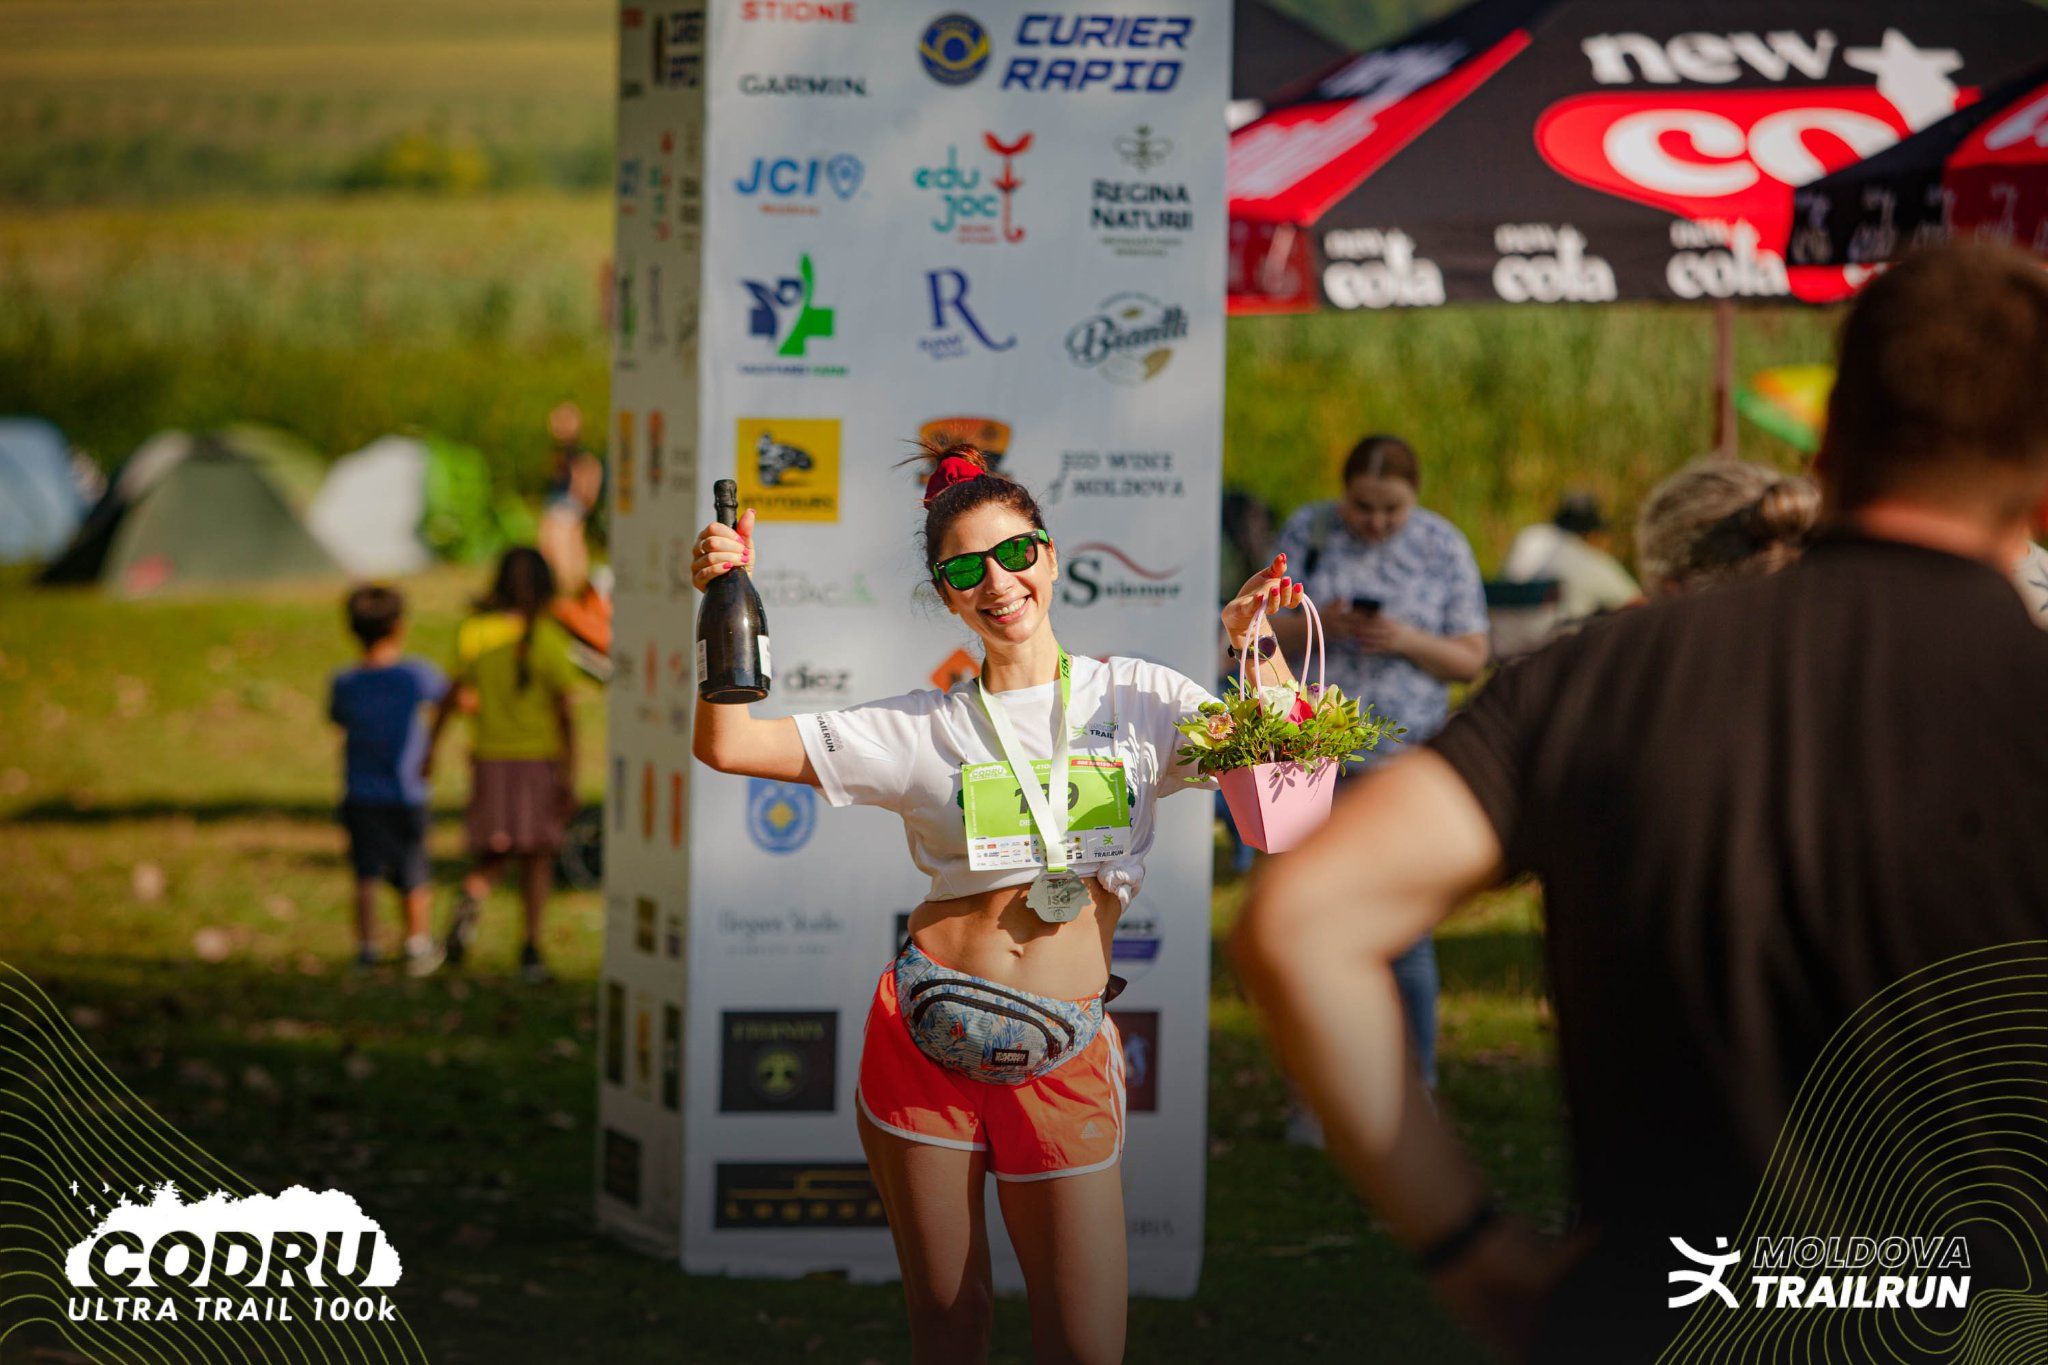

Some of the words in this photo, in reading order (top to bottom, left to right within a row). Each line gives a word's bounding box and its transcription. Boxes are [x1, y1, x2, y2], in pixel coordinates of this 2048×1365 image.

[1016, 15, 1193, 49] CURIER
[1001, 58, 1183, 92] RAPID
[1581, 30, 1838, 84] new
[740, 75, 869, 96] GARMIN
[735, 157, 820, 196] JCI
[914, 146, 980, 190] edu
[1092, 179, 1190, 202] REGINA
[1323, 230, 1446, 309] cola
[1492, 224, 1617, 302] cola
[1666, 219, 1790, 298] cola
[783, 665, 849, 691] diez
[1090, 729, 1114, 740] TRAIL
